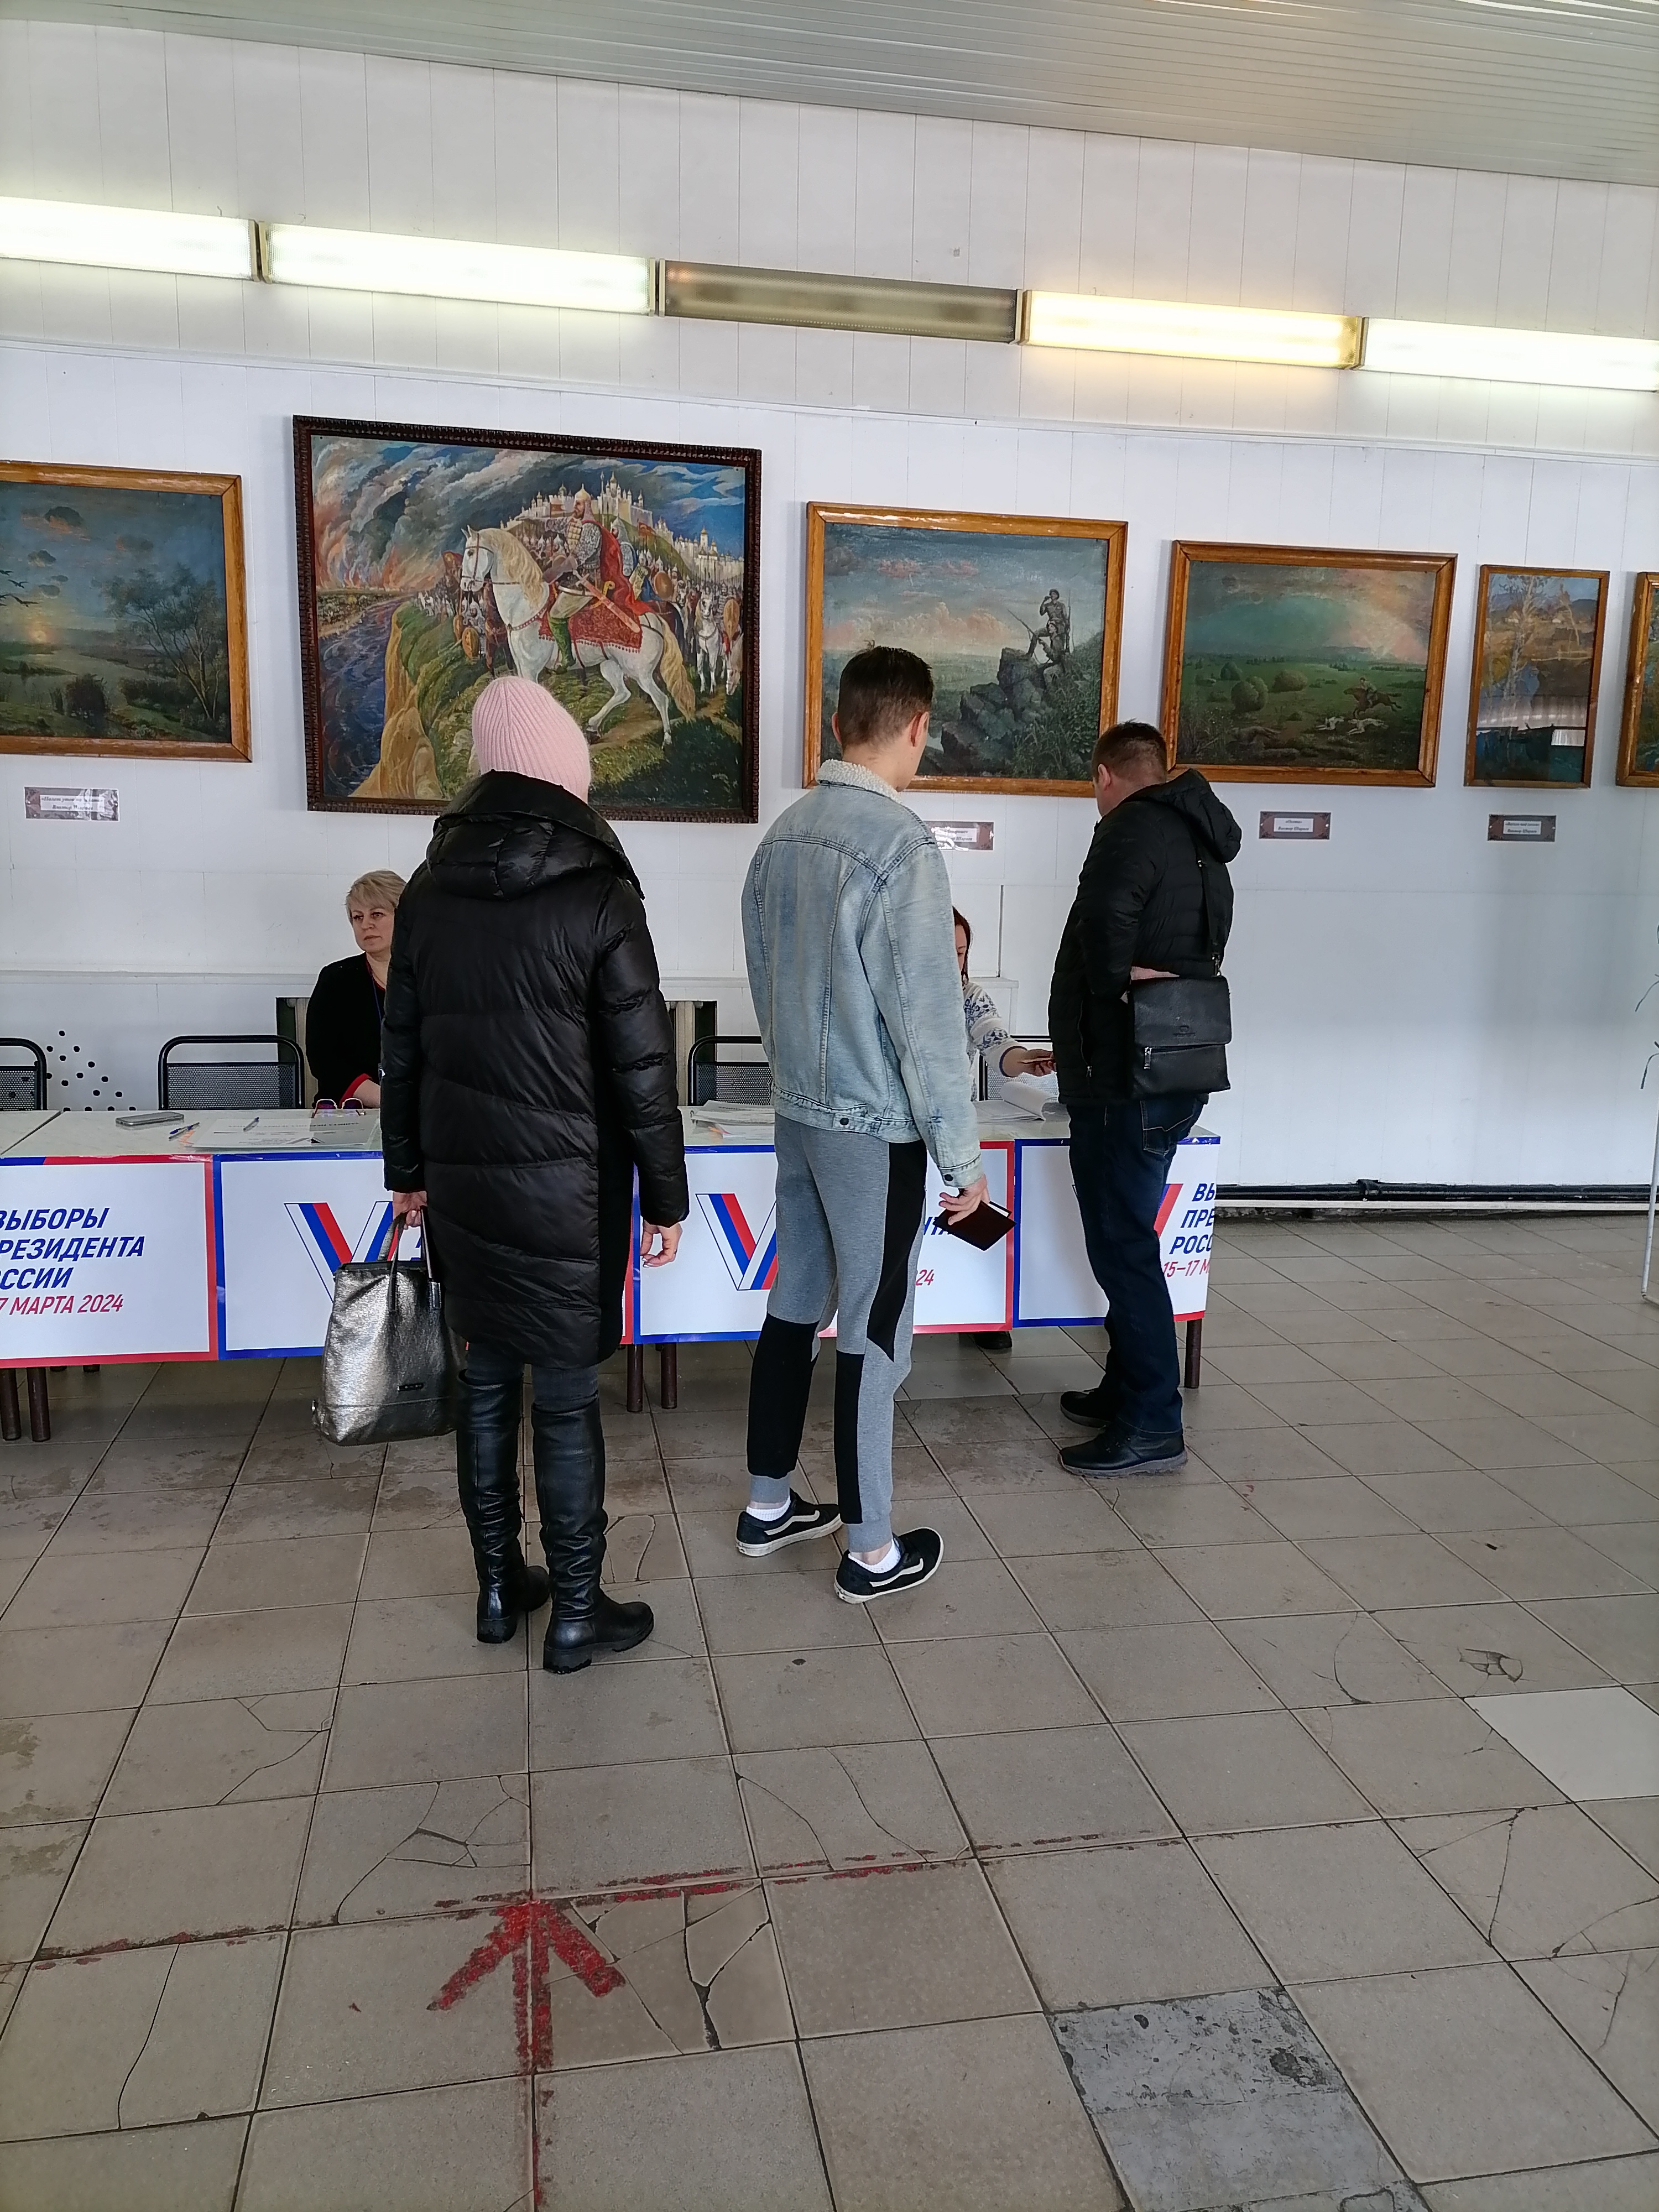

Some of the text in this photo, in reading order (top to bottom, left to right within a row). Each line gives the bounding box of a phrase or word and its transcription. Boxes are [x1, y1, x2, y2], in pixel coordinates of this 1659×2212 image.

[0, 1236, 145, 1262] РЕЗИДЕНТА
[0, 1267, 74, 1290] ССИИ
[915, 1269, 935, 1286] 24
[9, 1296, 74, 1316] МАРТА
[77, 1294, 124, 1313] 2024
